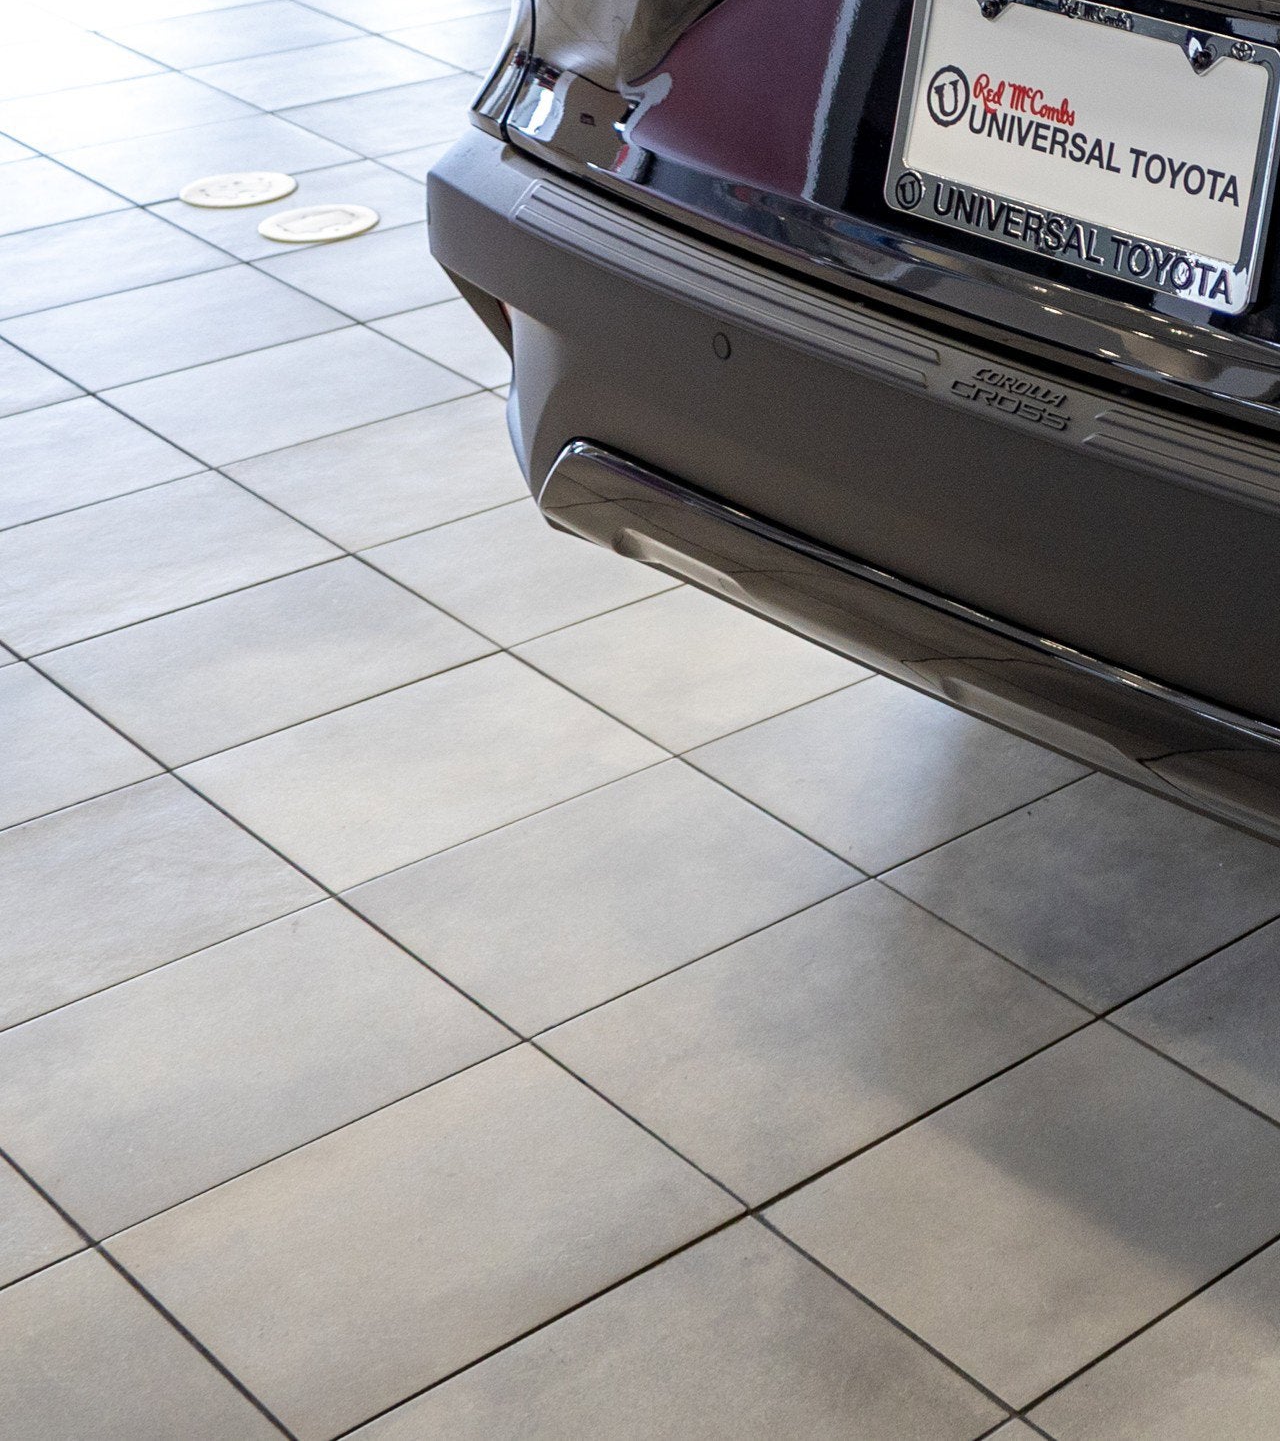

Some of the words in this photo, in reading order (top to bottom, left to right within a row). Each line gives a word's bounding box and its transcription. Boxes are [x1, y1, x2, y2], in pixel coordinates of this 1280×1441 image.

[973, 73, 1005, 114] Red
[1009, 81, 1076, 127] McCombs
[968, 103, 1121, 175] UNIVERSAL
[1129, 148, 1240, 207] TOYOTA
[933, 182, 1105, 265] UNIVERSAL
[1111, 235, 1233, 306] TOYOTA
[951, 379, 1071, 432] CROSS
[972, 368, 1068, 408] COROLLA
